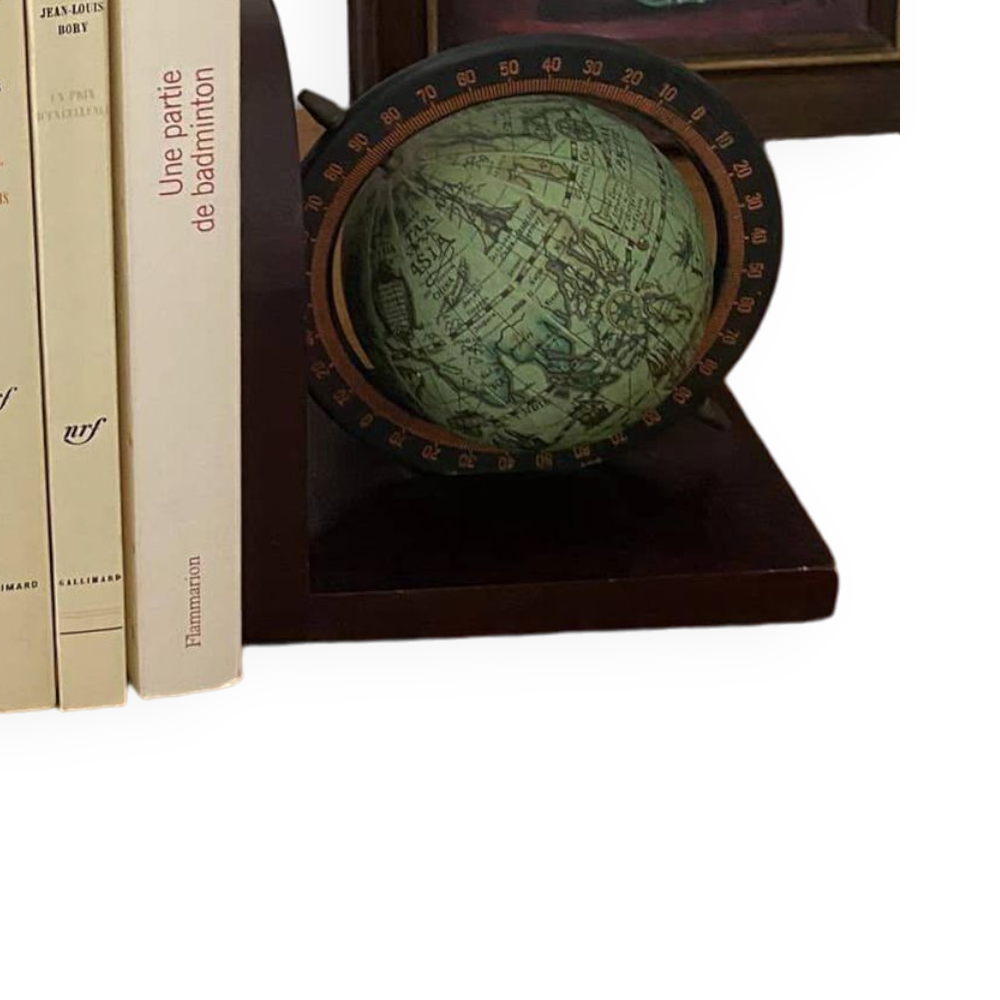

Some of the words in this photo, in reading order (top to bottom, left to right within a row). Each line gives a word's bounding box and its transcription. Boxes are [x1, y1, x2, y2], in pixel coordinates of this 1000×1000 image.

[40, 1, 104, 18] JEAN-LOUIS
[499, 59, 520, 76] 50
[541, 56, 562, 73] 40
[582, 59, 604, 77] 30
[456, 69, 477, 87] 60
[621, 68, 643, 86] 20
[416, 84, 438, 104] 70
[659, 82, 678, 102] 10
[157, 69, 188, 138] partie
[691, 105, 706, 120] 0
[380, 106, 401, 125] 80
[190, 67, 215, 196] badminton
[715, 130, 735, 149] 10
[348, 133, 369, 152] 90
[158, 148, 183, 197] Une
[733, 159, 753, 179] 20
[746, 192, 763, 211] 30
[191, 204, 215, 232] de
[747, 262, 765, 279] 50
[64, 417, 107, 446] nrf
[185, 555, 202, 648] Flammarion
